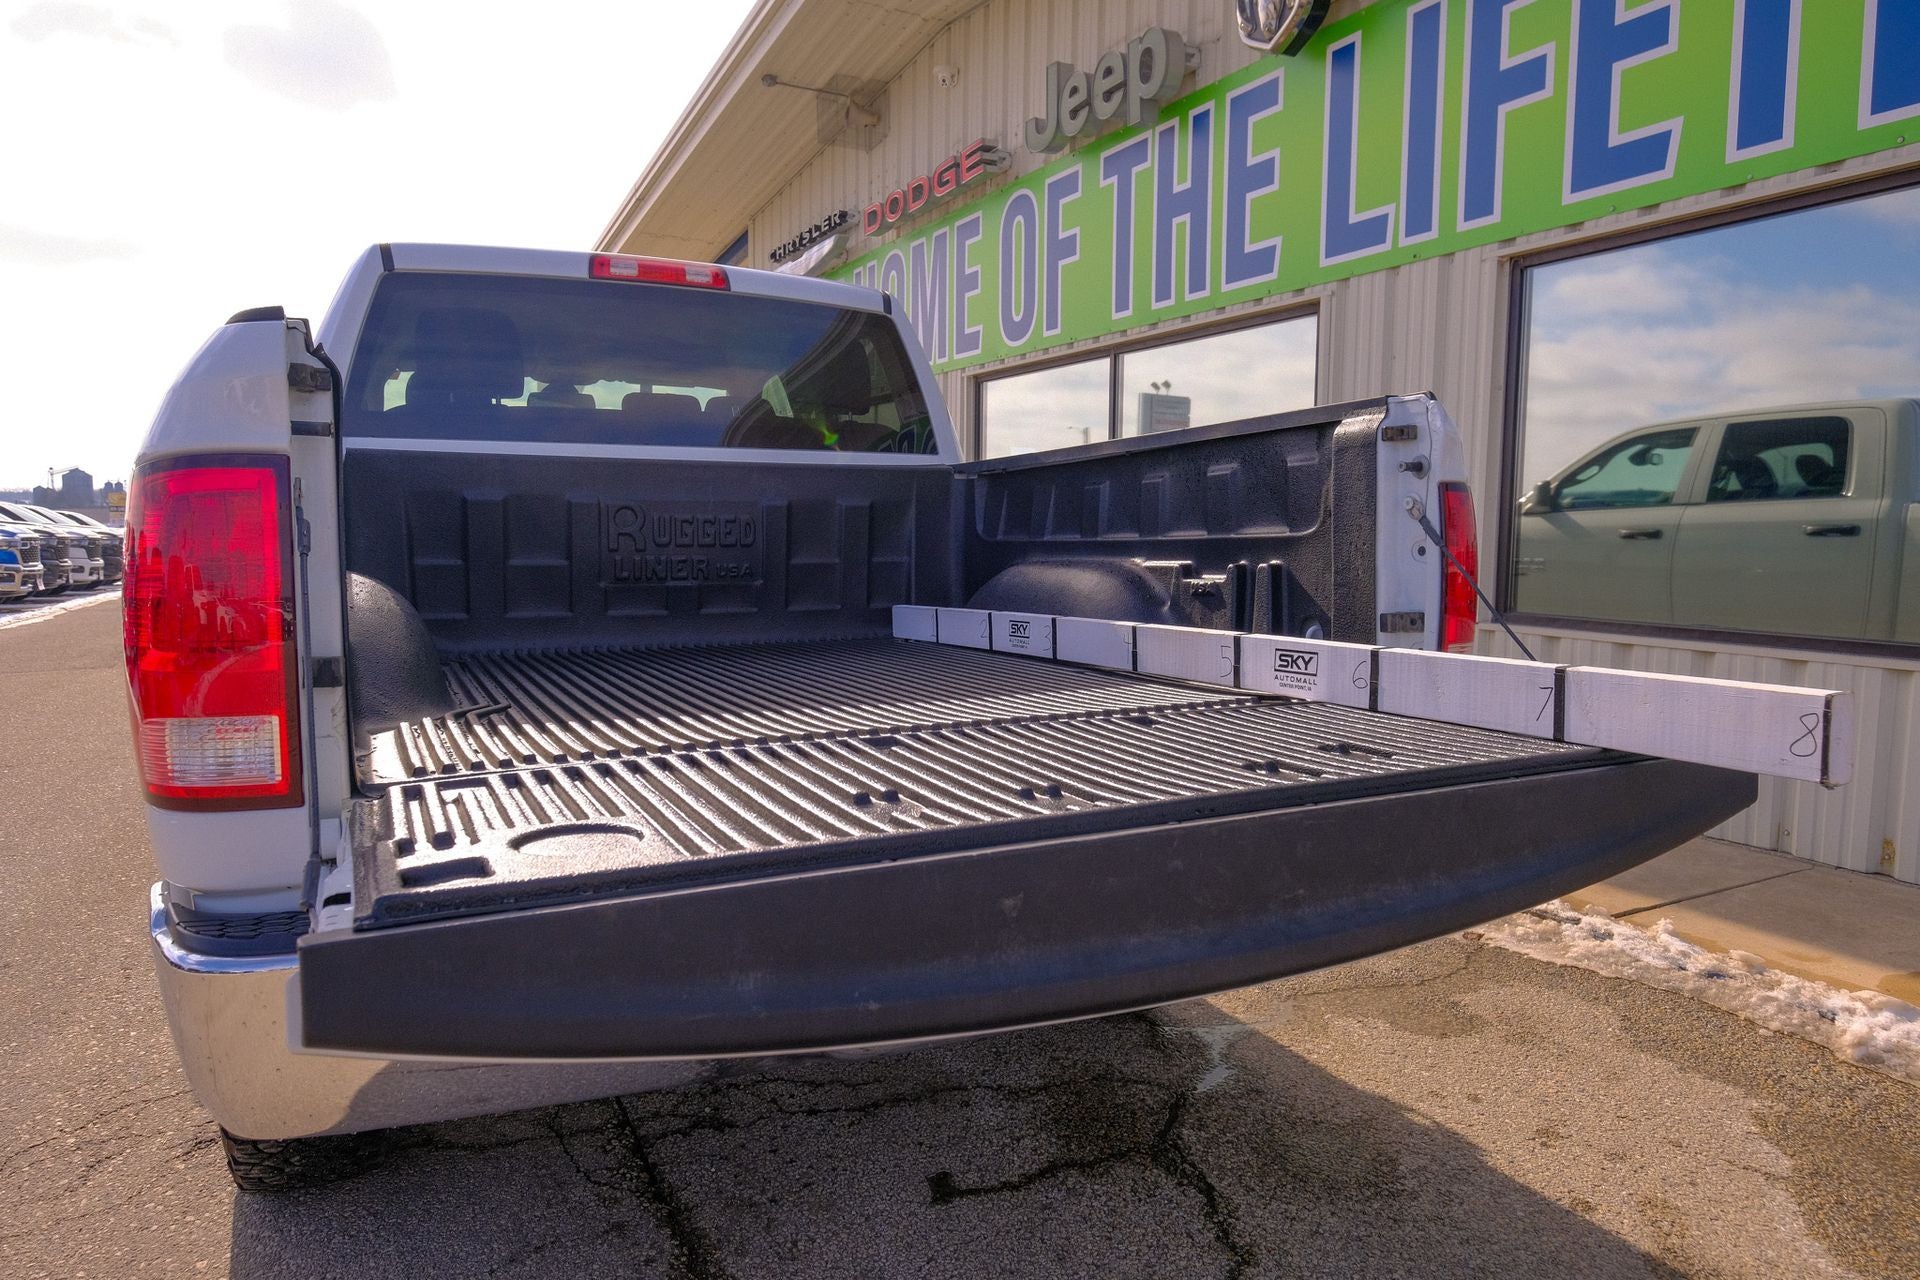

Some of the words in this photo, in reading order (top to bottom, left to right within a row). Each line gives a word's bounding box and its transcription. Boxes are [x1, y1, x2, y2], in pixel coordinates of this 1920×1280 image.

[1025, 26, 1180, 153] Jeep
[864, 137, 986, 236] DODGE
[853, 210, 983, 366] ME
[1000, 163, 1082, 347] OF
[1101, 67, 1285, 321] THE
[770, 209, 848, 262] CHRYSLER
[606, 502, 757, 552] RUGGED
[614, 555, 710, 582] LINER
[716, 562, 753, 578] USA
[1010, 623, 1029, 635] SKY
[1040, 624, 1051, 652] 3
[1220, 645, 1232, 677] 5
[1277, 653, 1314, 671] SKY
[1353, 660, 1368, 689] 6
[1274, 674, 1317, 685] AUTOMALL
[1536, 686, 1554, 722] 7
[1789, 712, 1820, 758] 8
